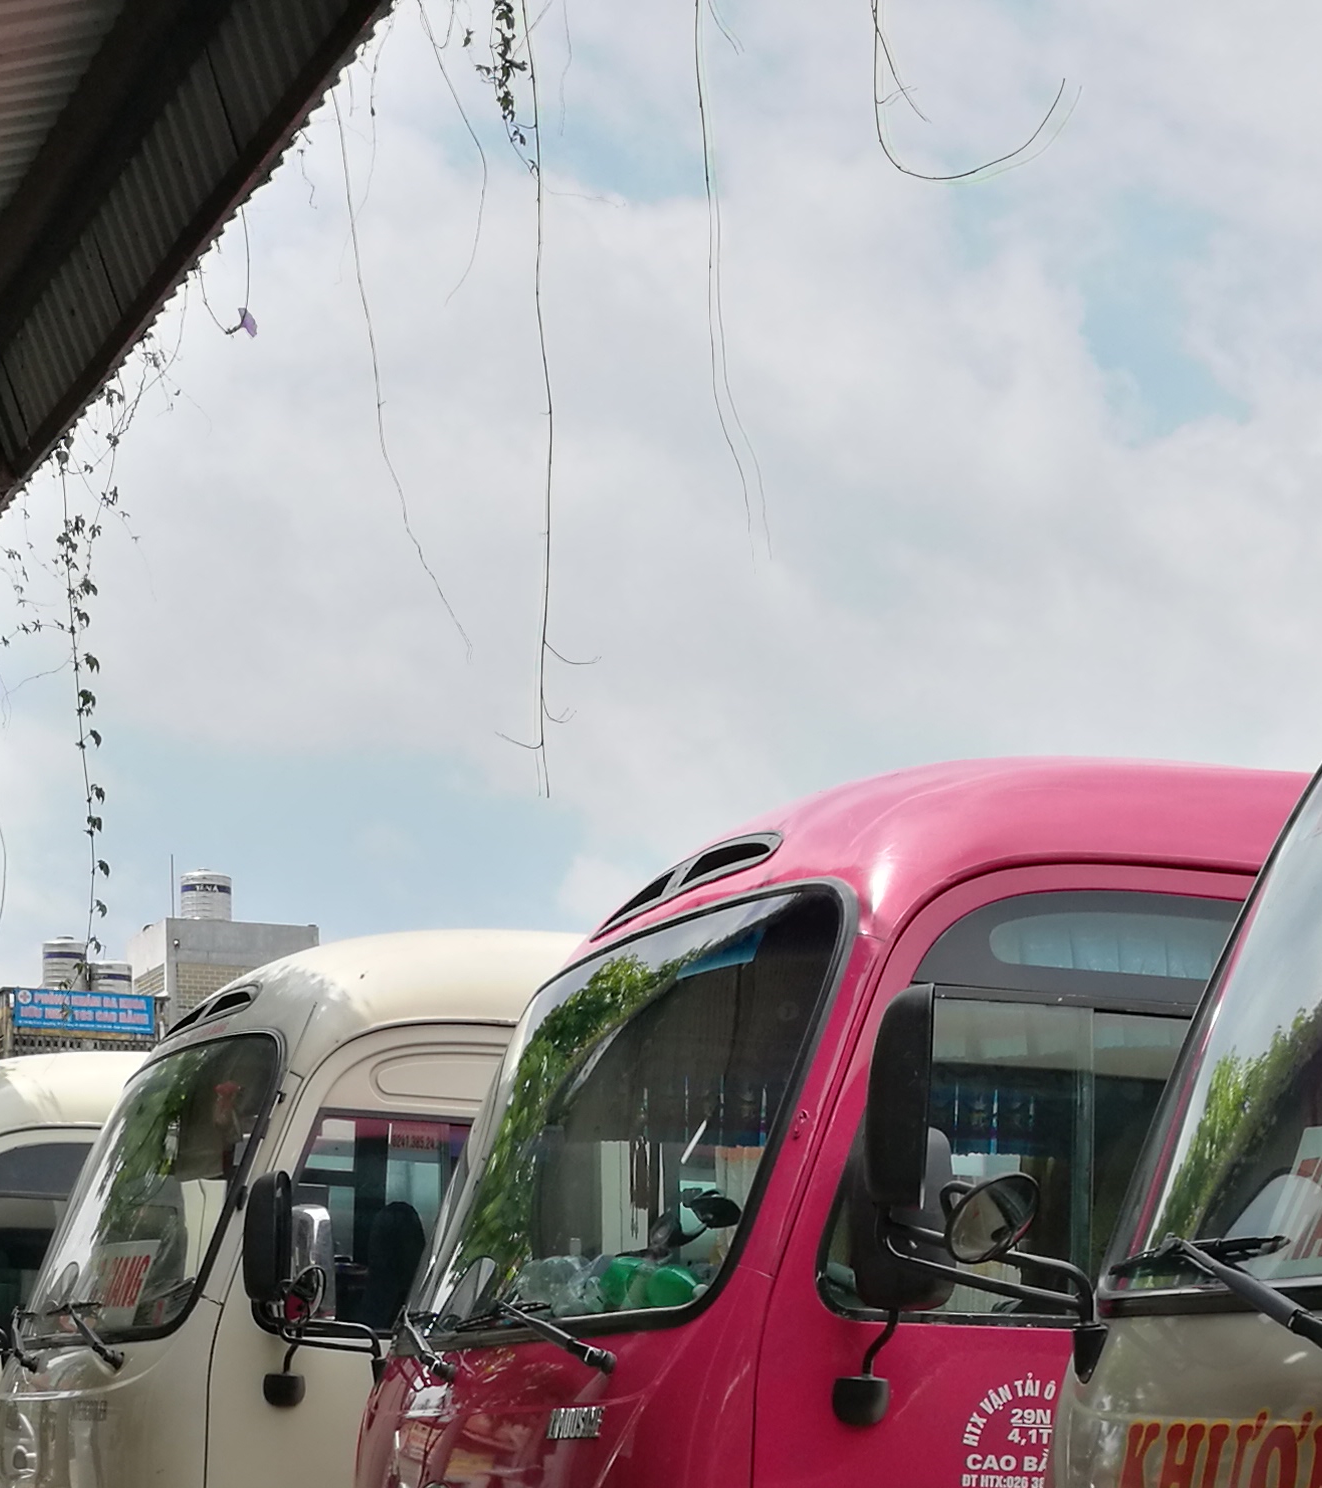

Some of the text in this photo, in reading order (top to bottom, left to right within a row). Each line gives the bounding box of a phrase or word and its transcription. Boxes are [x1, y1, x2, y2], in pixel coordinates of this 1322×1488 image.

[962, 1372, 1056, 1447] HTX VẬN TẢI Ô
[1010, 1408, 1051, 1424] 29N
[966, 1453, 1017, 1472] CAO
[961, 1474, 977, 1487] ĐT
